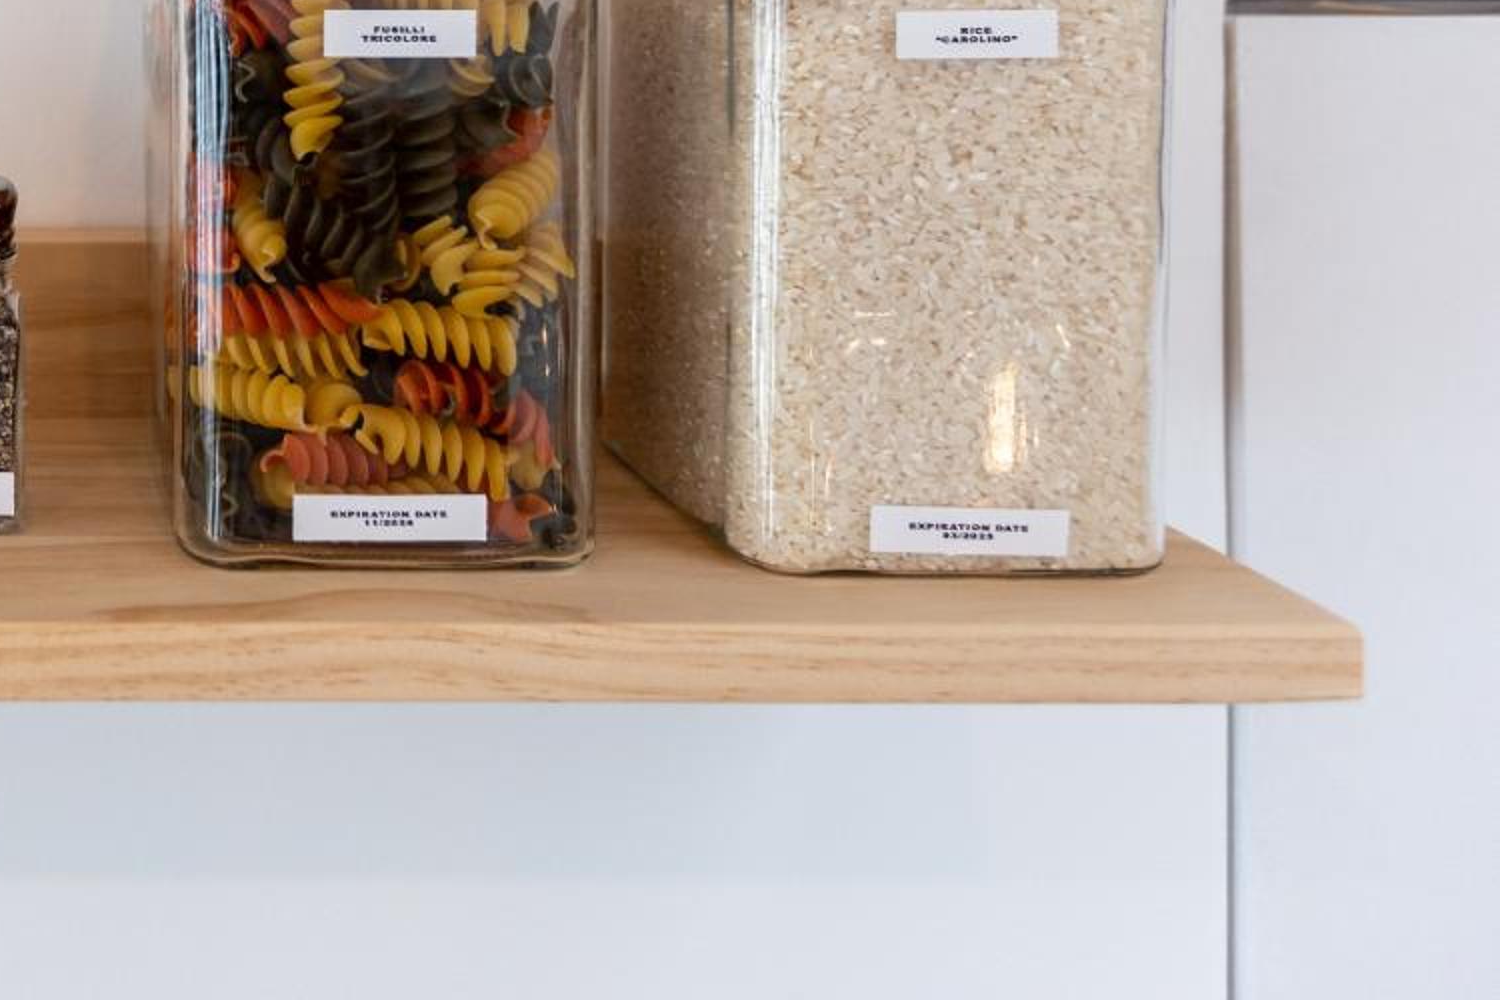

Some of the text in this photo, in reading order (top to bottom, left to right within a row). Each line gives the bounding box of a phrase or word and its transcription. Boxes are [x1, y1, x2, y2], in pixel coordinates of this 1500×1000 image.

[373, 26, 425, 34] FUSILLI
[960, 27, 992, 35] RICE
[906, 523, 1029, 533] EXPIRATION DATE
